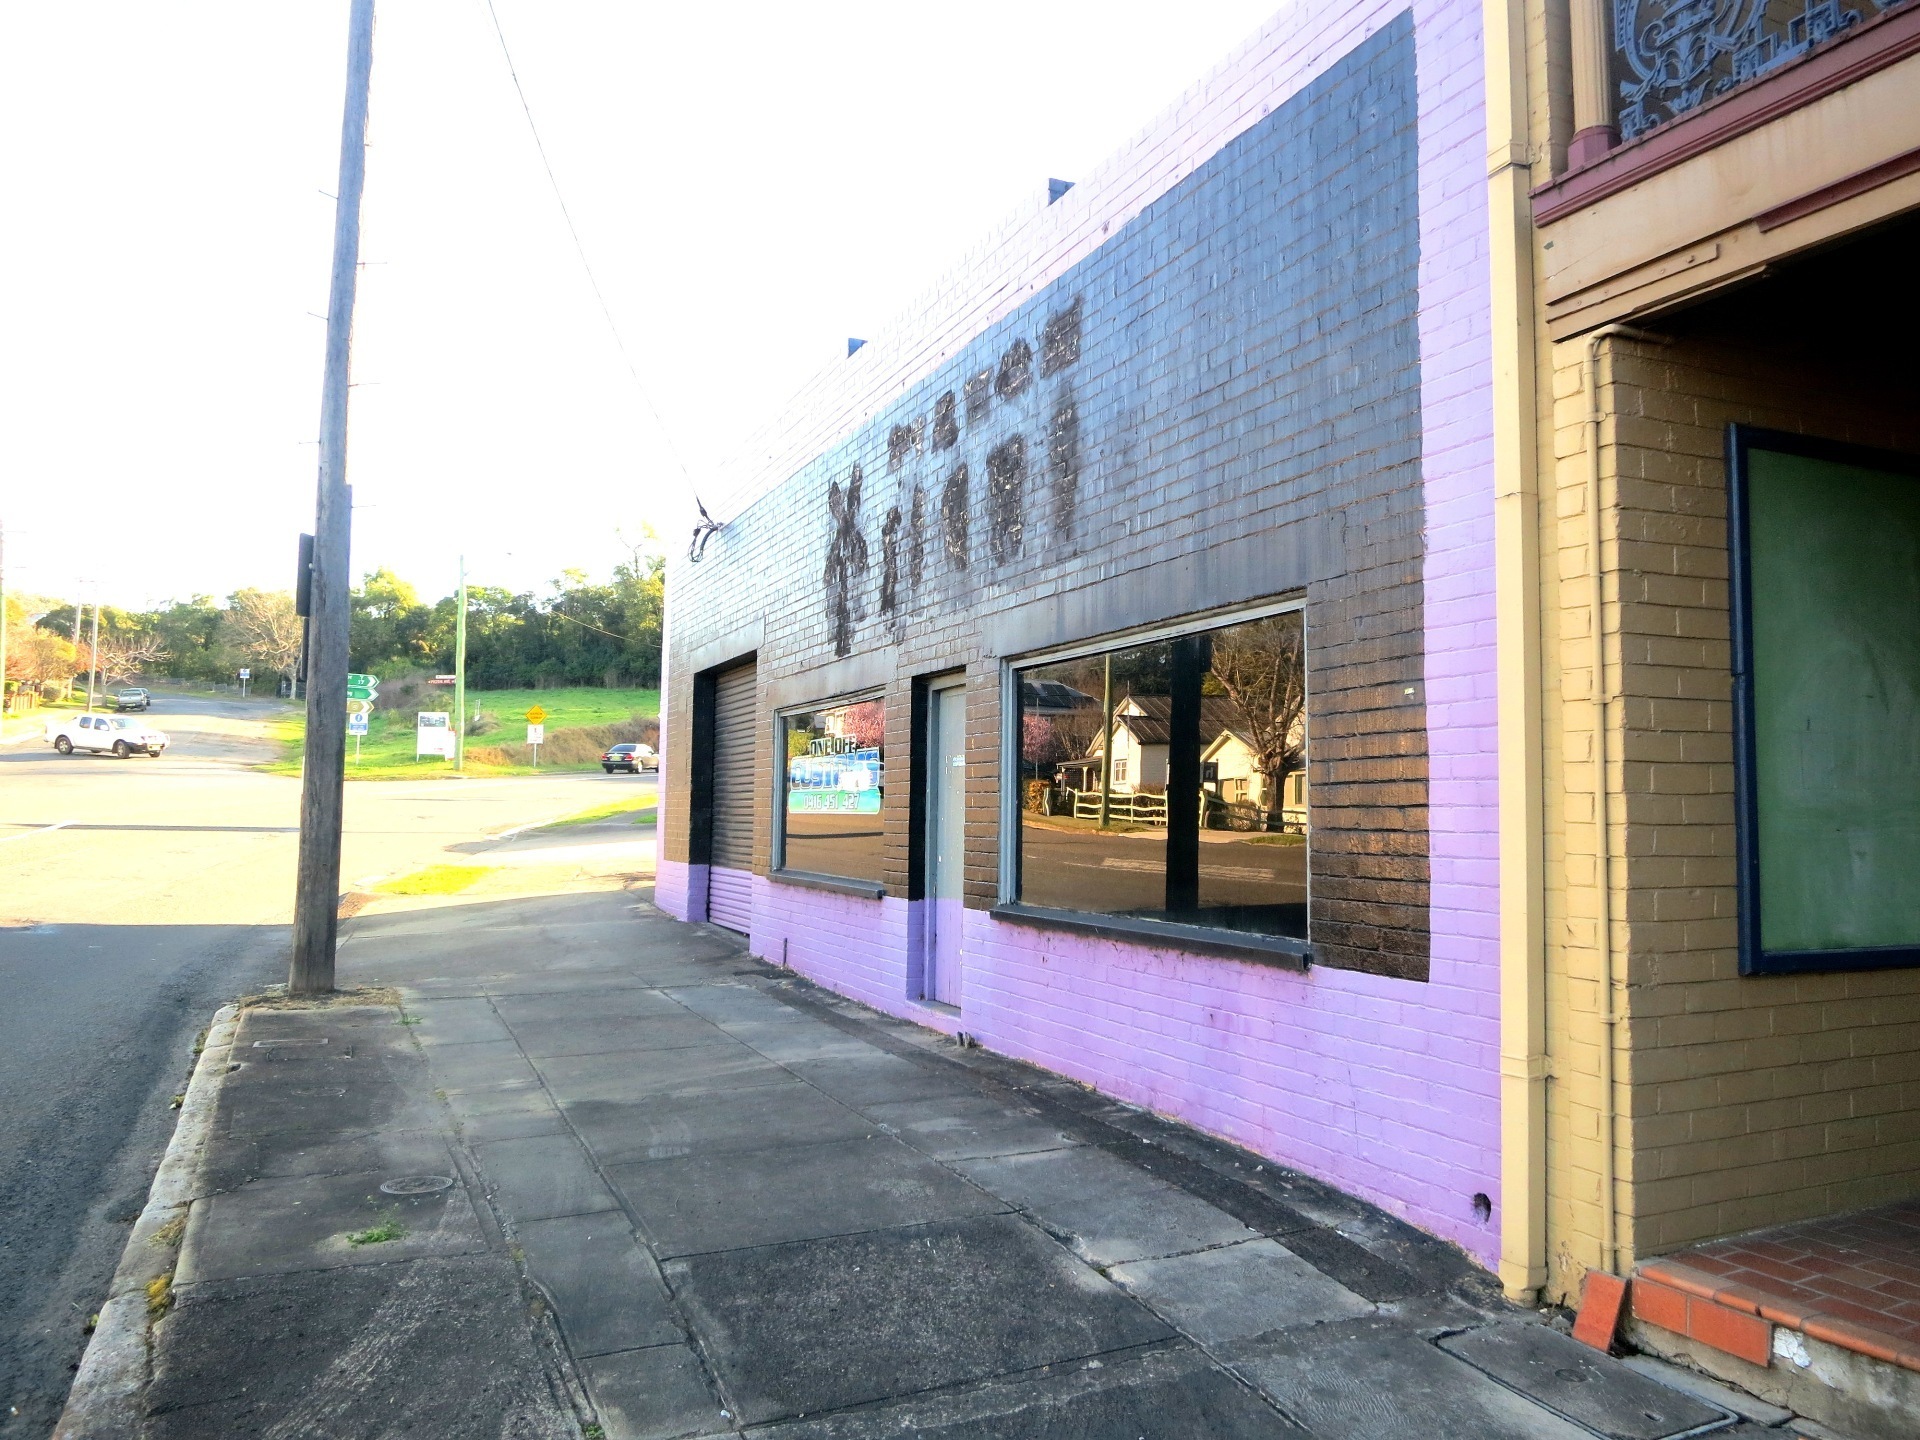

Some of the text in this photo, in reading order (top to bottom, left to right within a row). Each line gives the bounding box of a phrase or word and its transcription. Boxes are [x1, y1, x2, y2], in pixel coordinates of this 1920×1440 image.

[810, 735, 856, 756] ONE OFF
[803, 793, 860, 810] 0416 451 427
